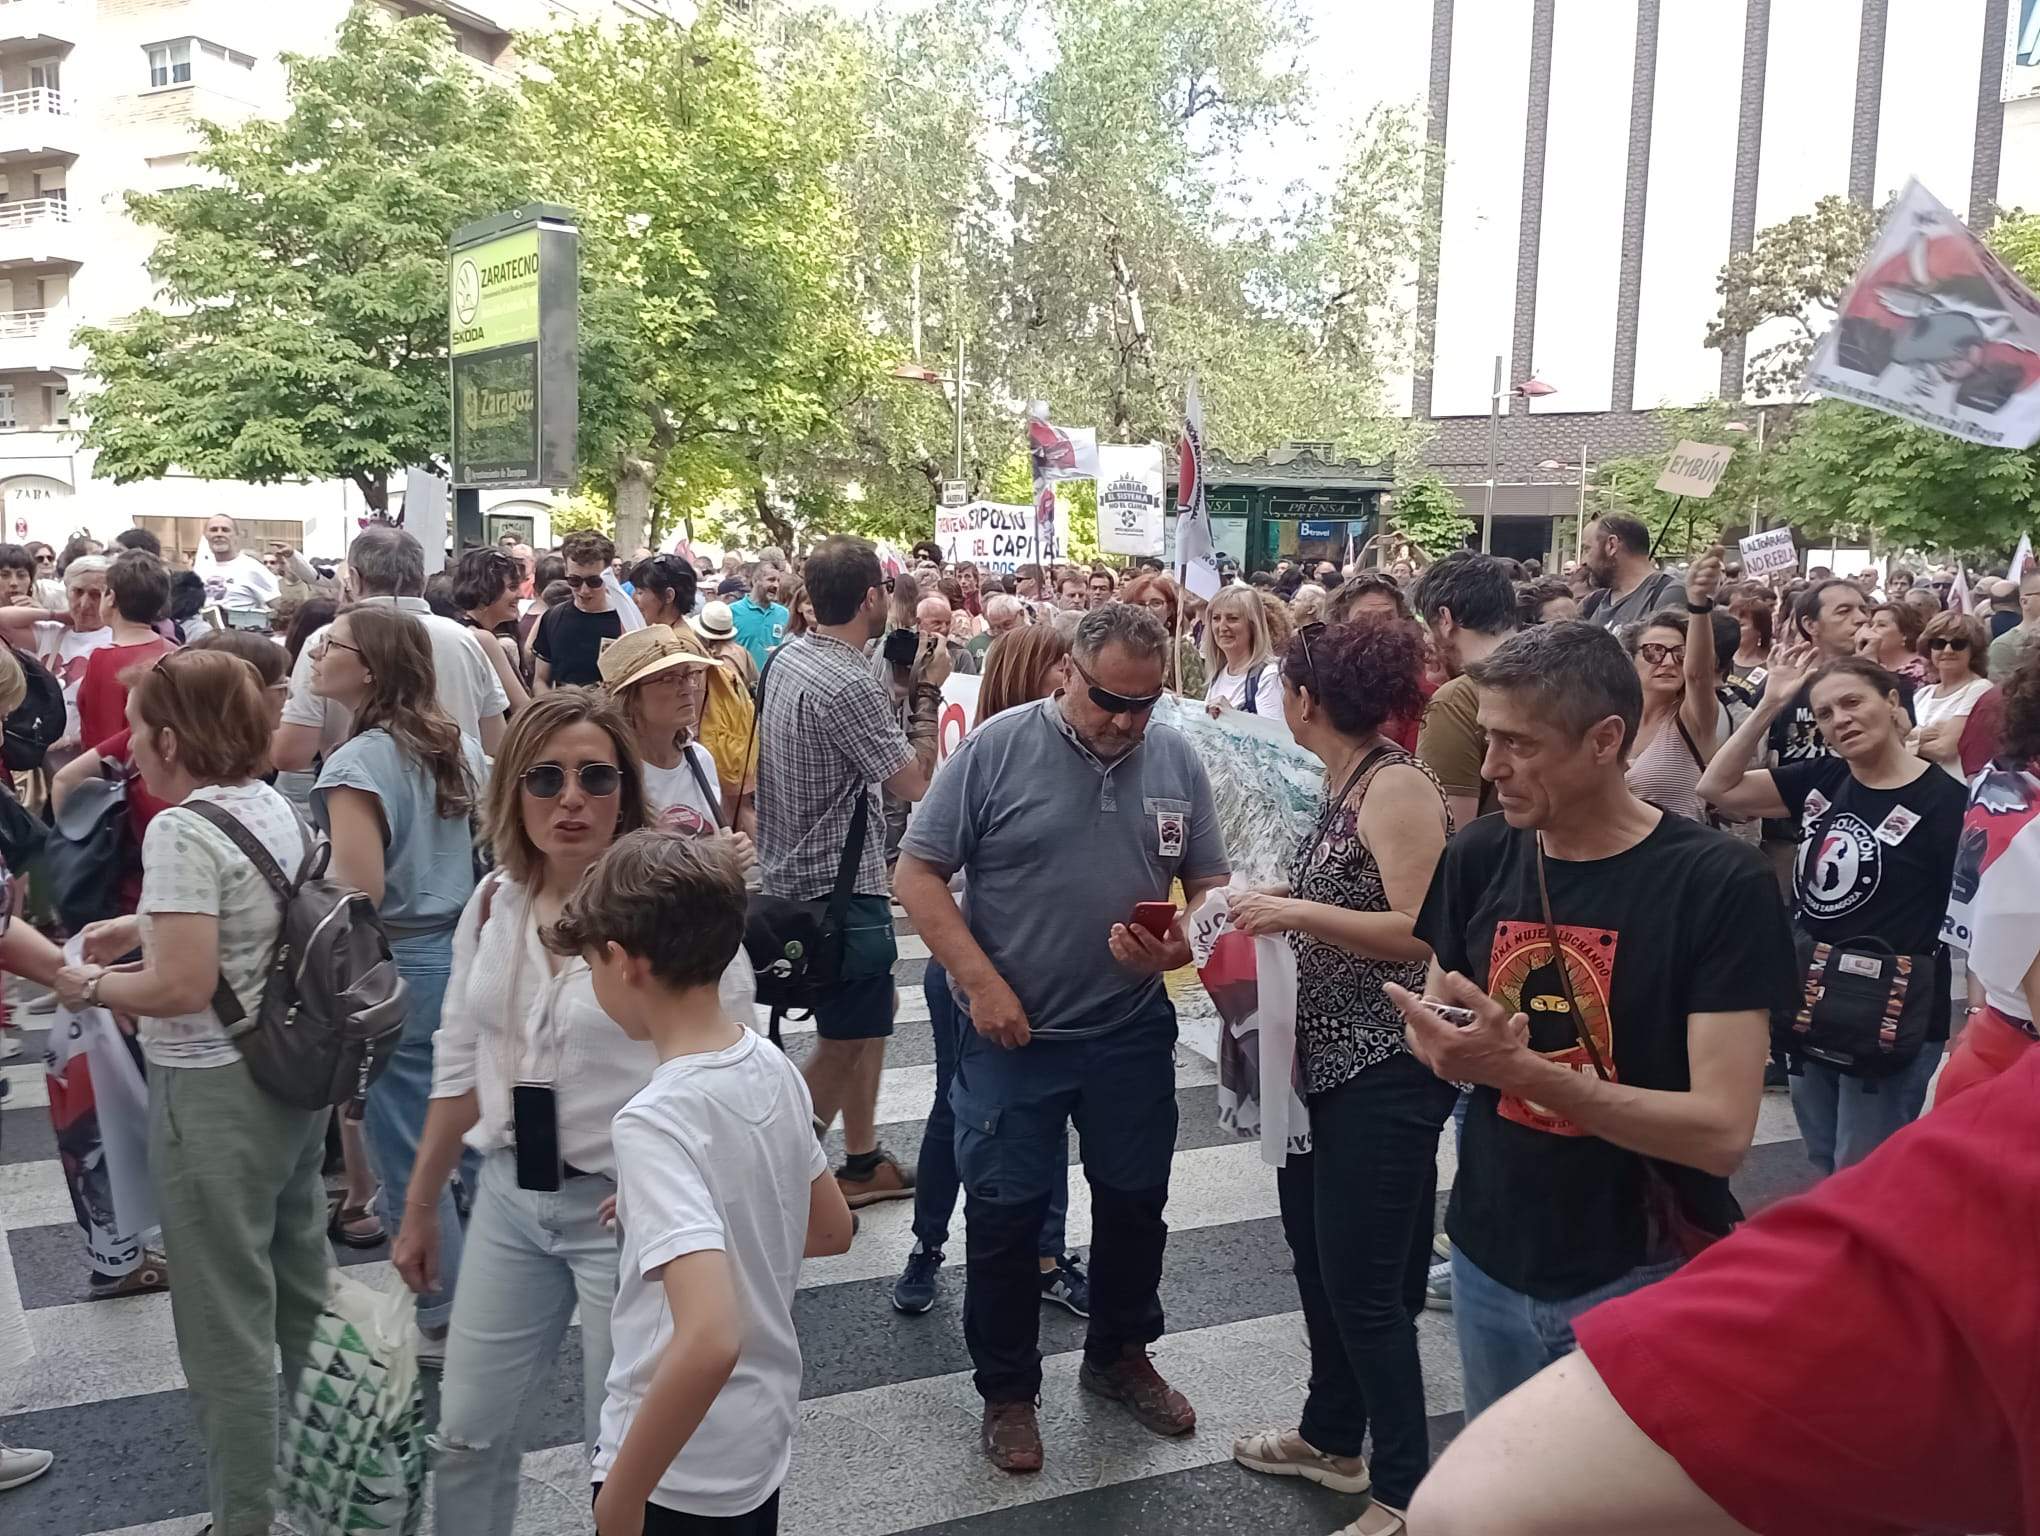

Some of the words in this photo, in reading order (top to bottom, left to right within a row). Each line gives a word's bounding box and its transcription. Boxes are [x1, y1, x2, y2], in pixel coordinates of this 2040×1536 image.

[481, 252, 539, 288] ZARATECNO
[1669, 451, 1726, 483] EMBÚN
[1107, 482, 1148, 493] CAMBIAR
[15, 489, 51, 500] ZARA
[1117, 494, 1148, 502] SISTEMA
[1108, 503, 1118, 511] NO
[1127, 503, 1148, 511] CLIMA
[1288, 503, 1345, 513] PRENSA
[1746, 557, 1765, 574] NO
[1492, 941, 1512, 964] UNA
[1558, 929, 1610, 977] LUCHANDO
